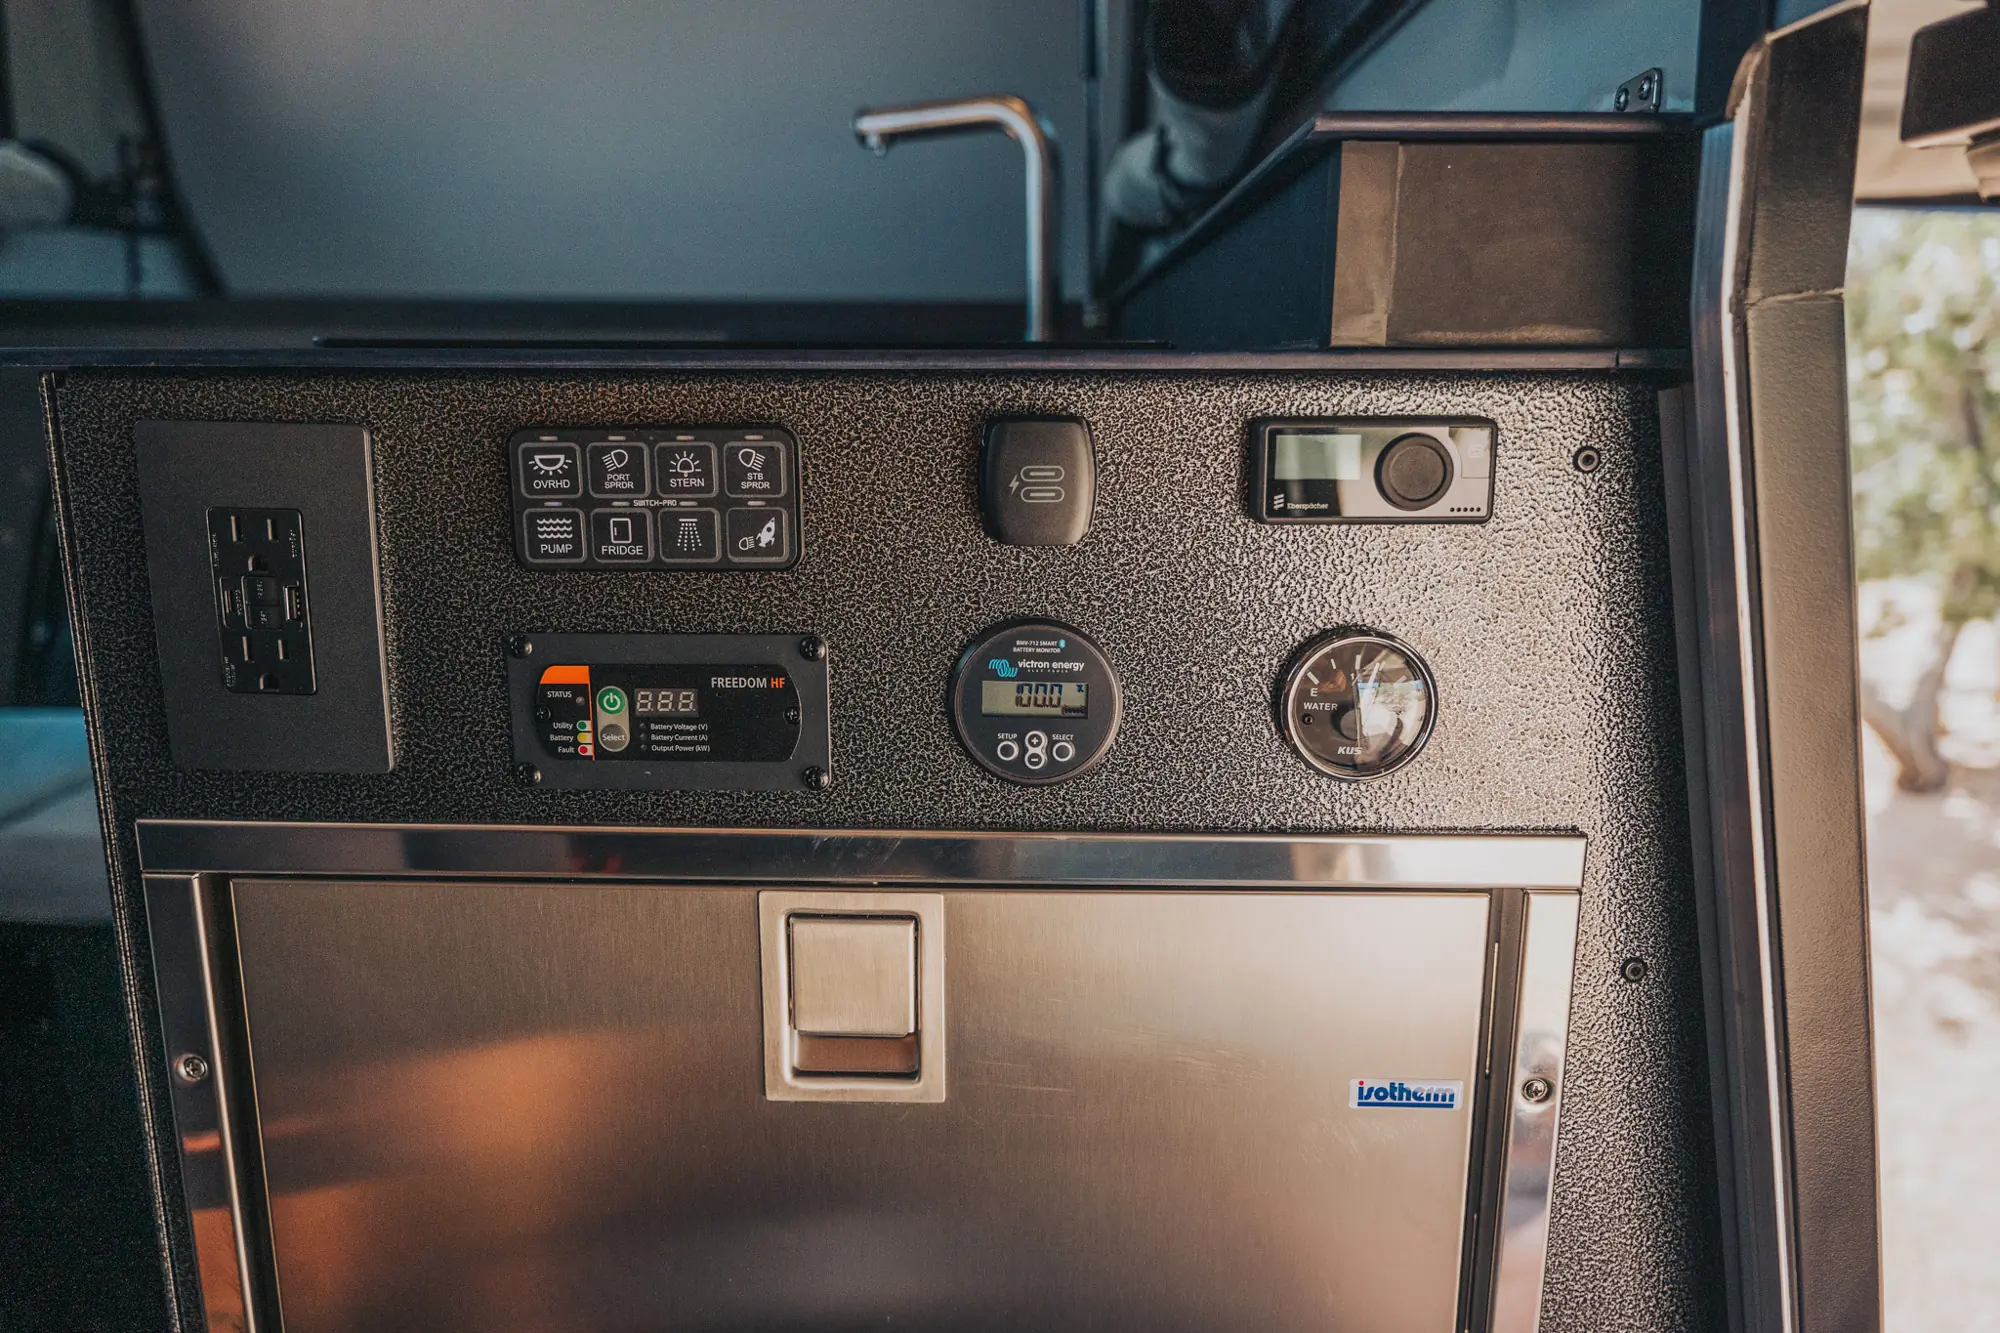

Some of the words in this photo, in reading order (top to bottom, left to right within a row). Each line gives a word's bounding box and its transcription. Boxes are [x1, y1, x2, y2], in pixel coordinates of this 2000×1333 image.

[607, 473, 631, 482] PORT
[747, 472, 764, 481] STB
[533, 479, 571, 489] OVRHD
[604, 481, 634, 490] SPRDR
[670, 478, 705, 488] STERN
[740, 480, 770, 489] SPRDR
[540, 544, 573, 554] PUMP
[601, 545, 643, 556] FRIDGE
[1018, 659, 1050, 668] victron
[1052, 661, 1085, 671] energy
[711, 677, 767, 689] FREEDOM
[770, 677, 786, 689] HF
[547, 690, 572, 698] STATUS
[1310, 687, 1318, 697] E
[1304, 703, 1338, 711] WATER
[553, 722, 573, 731] Utility
[650, 723, 674, 731] Battery
[674, 723, 697, 731] Voltage
[550, 734, 574, 742] Battery
[602, 733, 626, 741] Select
[651, 734, 674, 742] Battery
[651, 744, 674, 752] Output
[675, 744, 694, 752] Power
[1337, 746, 1363, 755] KUS
[1357, 1080, 1455, 1102] isotherm
